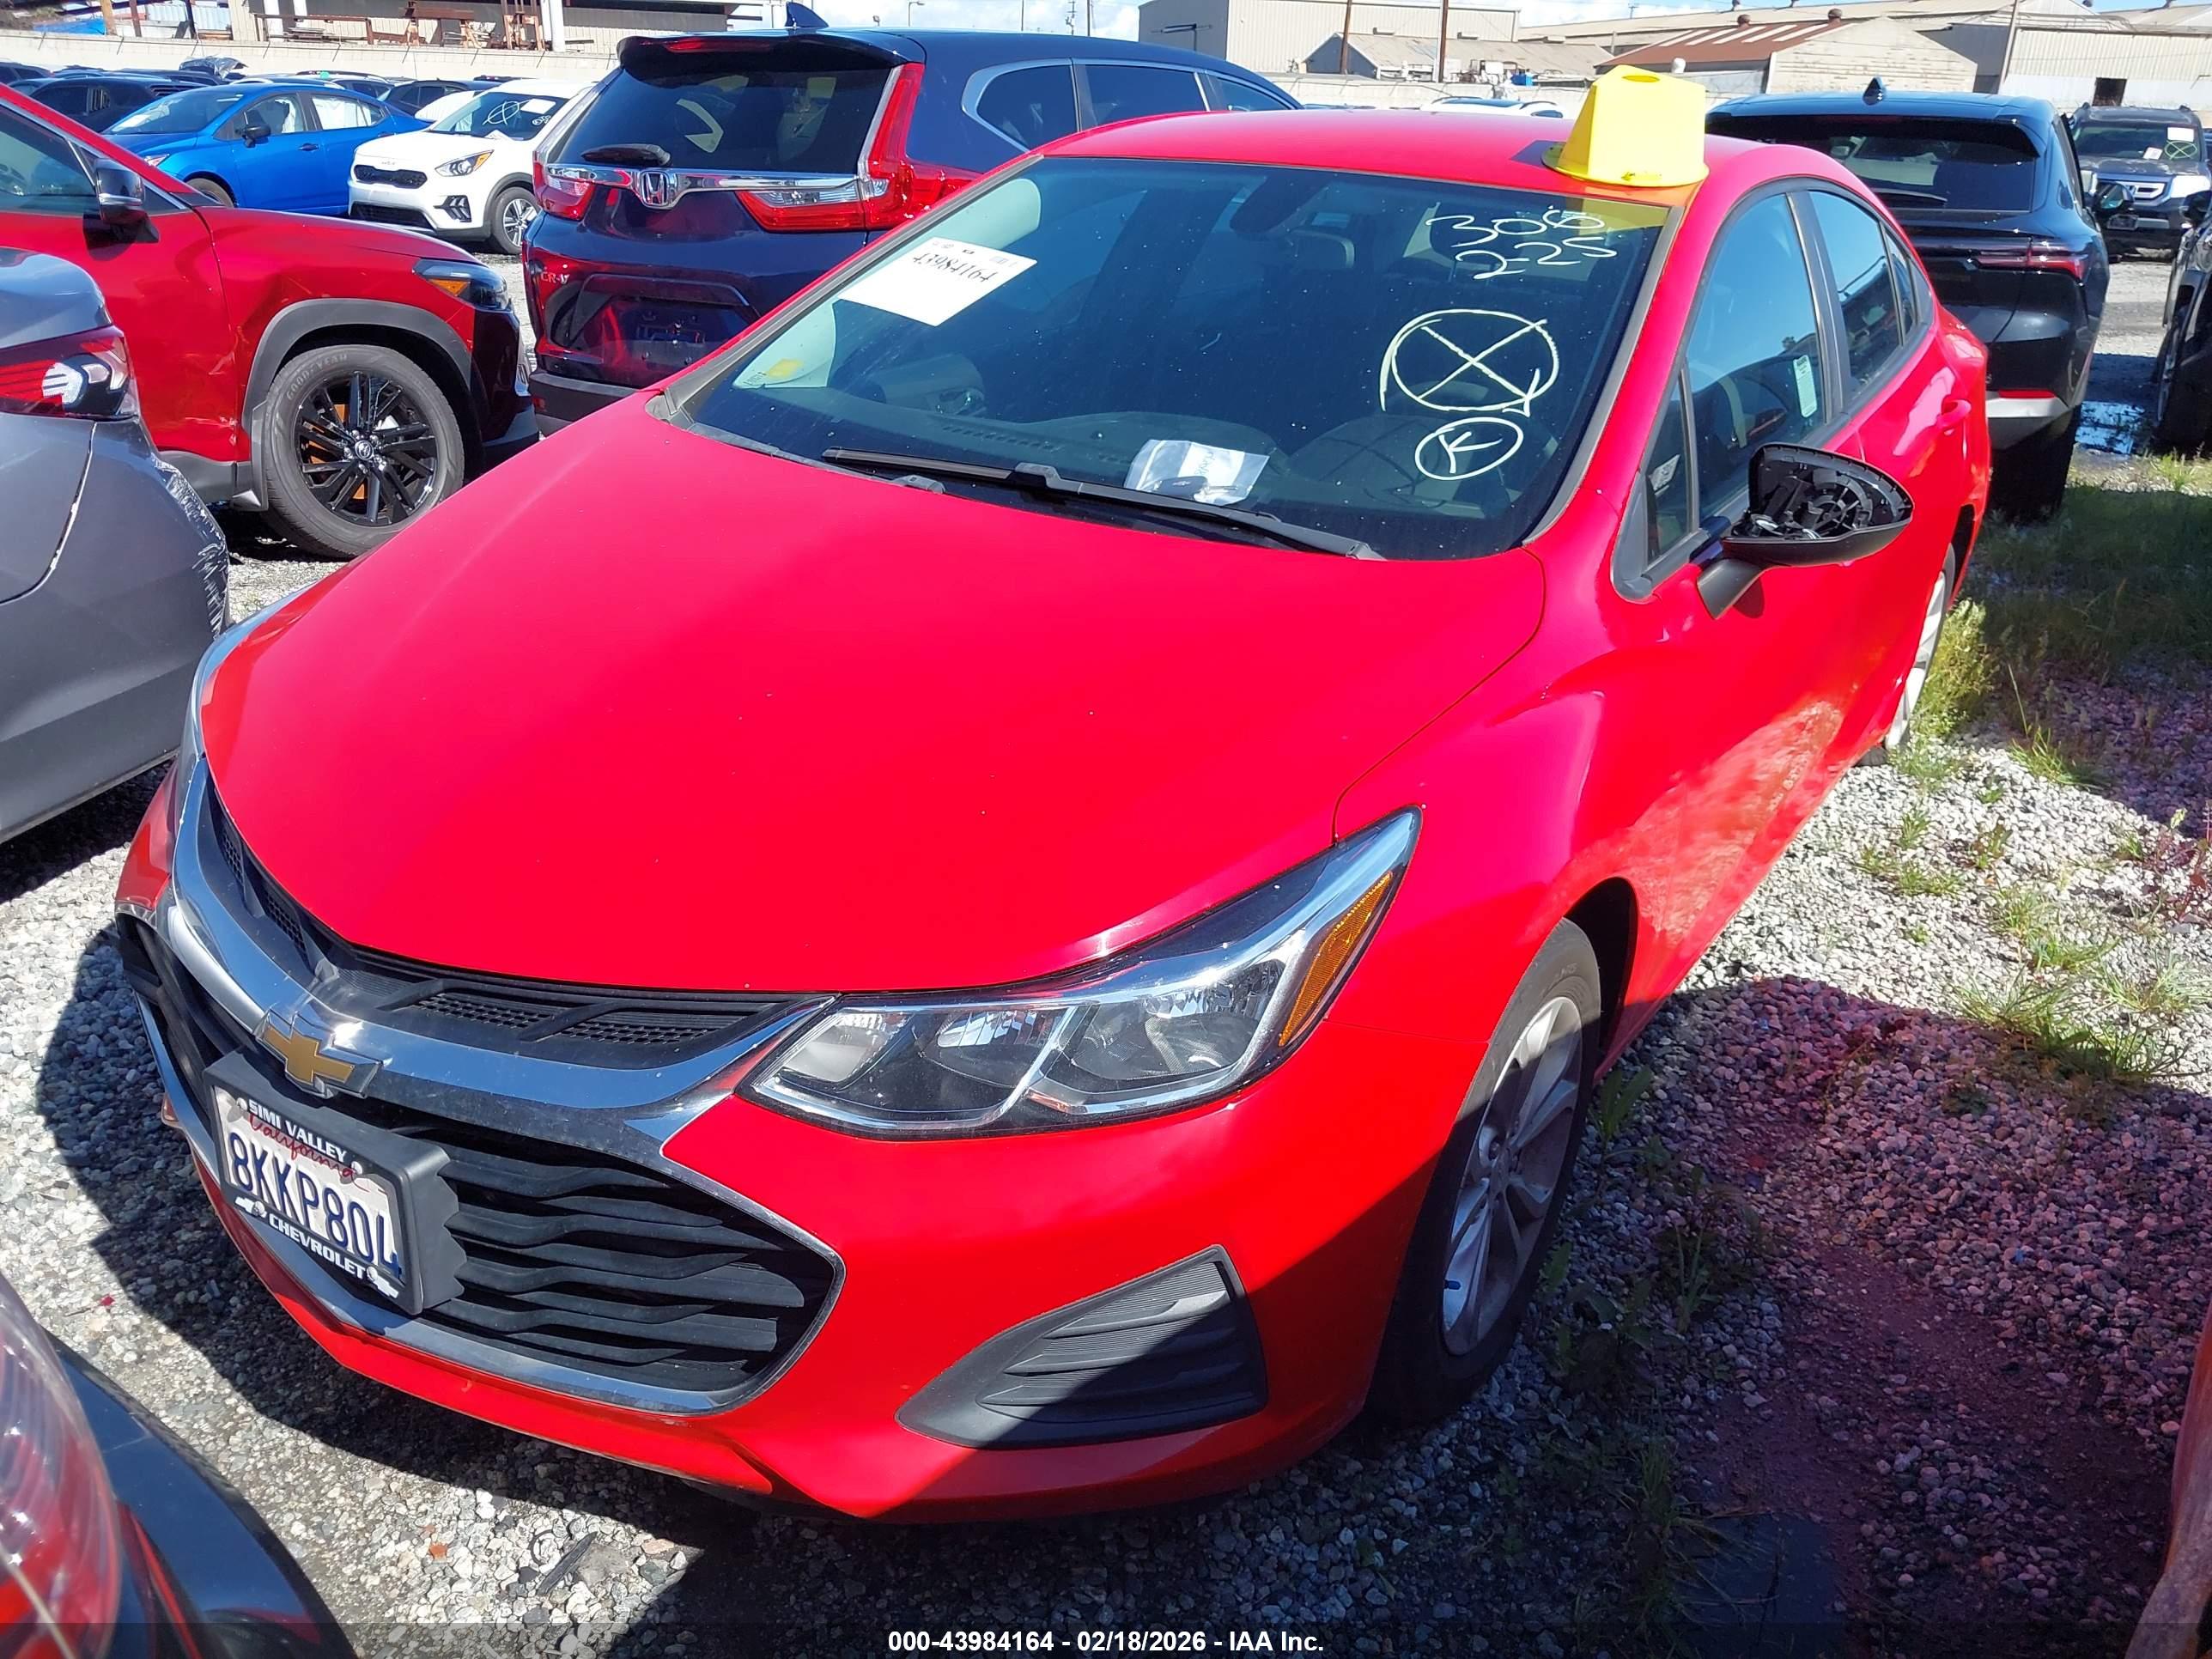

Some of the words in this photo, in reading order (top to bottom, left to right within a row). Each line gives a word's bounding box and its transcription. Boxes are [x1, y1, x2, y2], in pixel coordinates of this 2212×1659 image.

[248, 1099, 282, 1129] SIMI
[284, 1120, 348, 1163] VALLEY
[269, 1212, 367, 1279] CHEVROLET
